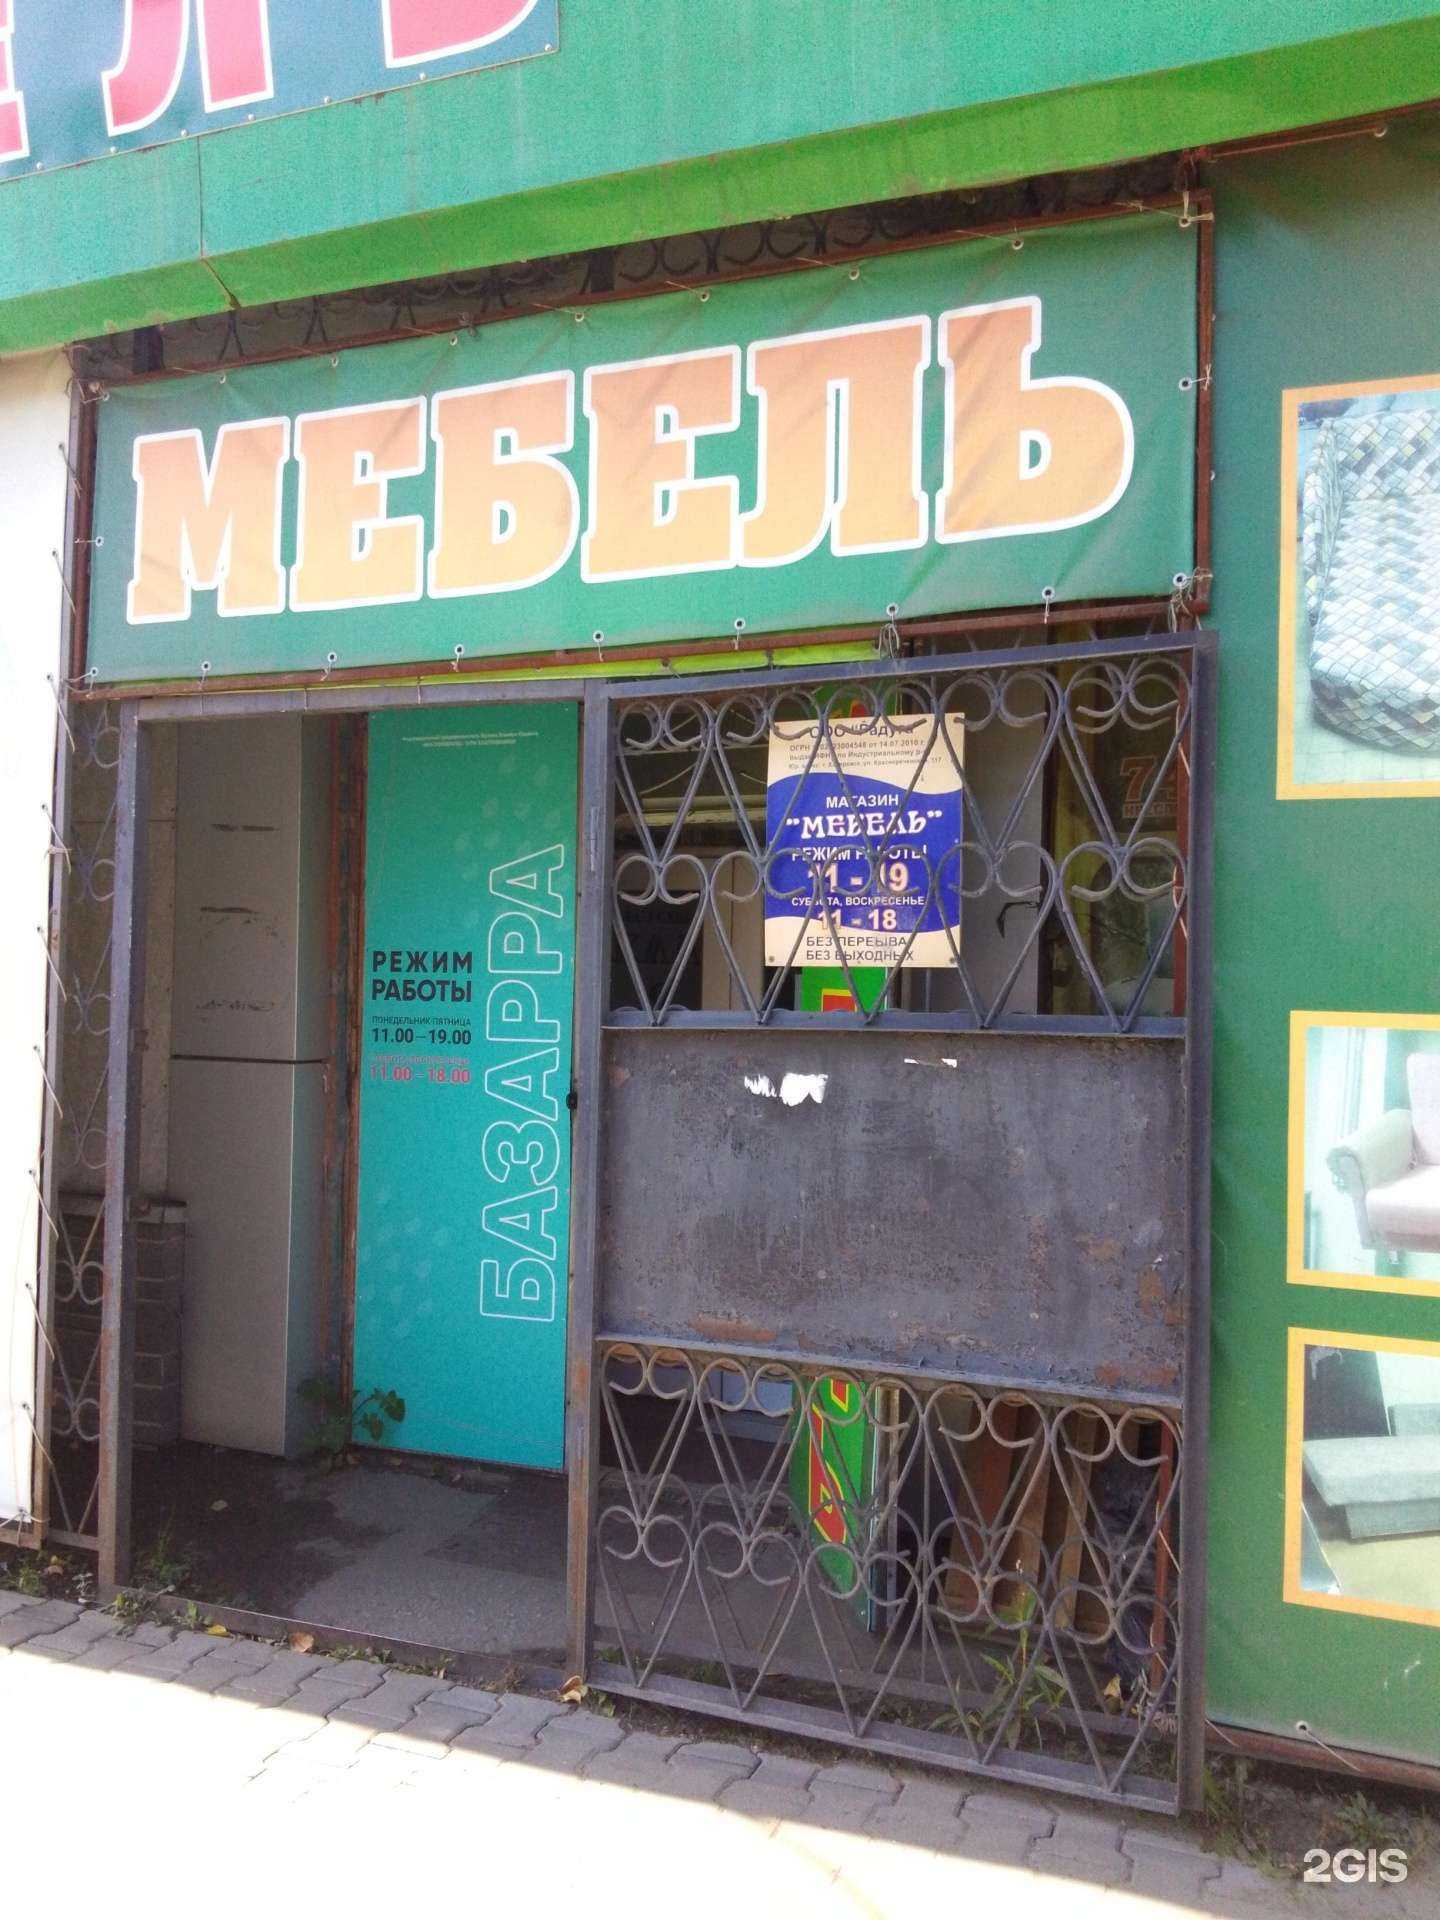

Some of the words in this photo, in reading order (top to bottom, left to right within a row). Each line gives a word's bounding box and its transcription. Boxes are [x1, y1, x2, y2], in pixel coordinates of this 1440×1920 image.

[126, 295, 1136, 625] МЕБЕЛЬ
[826, 795, 899, 809] МААЗИН
[792, 846, 851, 861] РЕЖИМ
[855, 845, 927, 860] РОТЫ
[792, 897, 843, 907] СУБТА,
[817, 908, 842, 930] 11
[867, 908, 898, 930] 18
[806, 936, 833, 947] БЕЗ
[372, 950, 473, 974] РЕЖИМ
[806, 950, 831, 961] БЕЗ
[835, 950, 914, 962] ВЫХОДНЫХ
[372, 978, 473, 1003] РАБОТЫ
[480, 843, 565, 1322] БАЗАРРА
